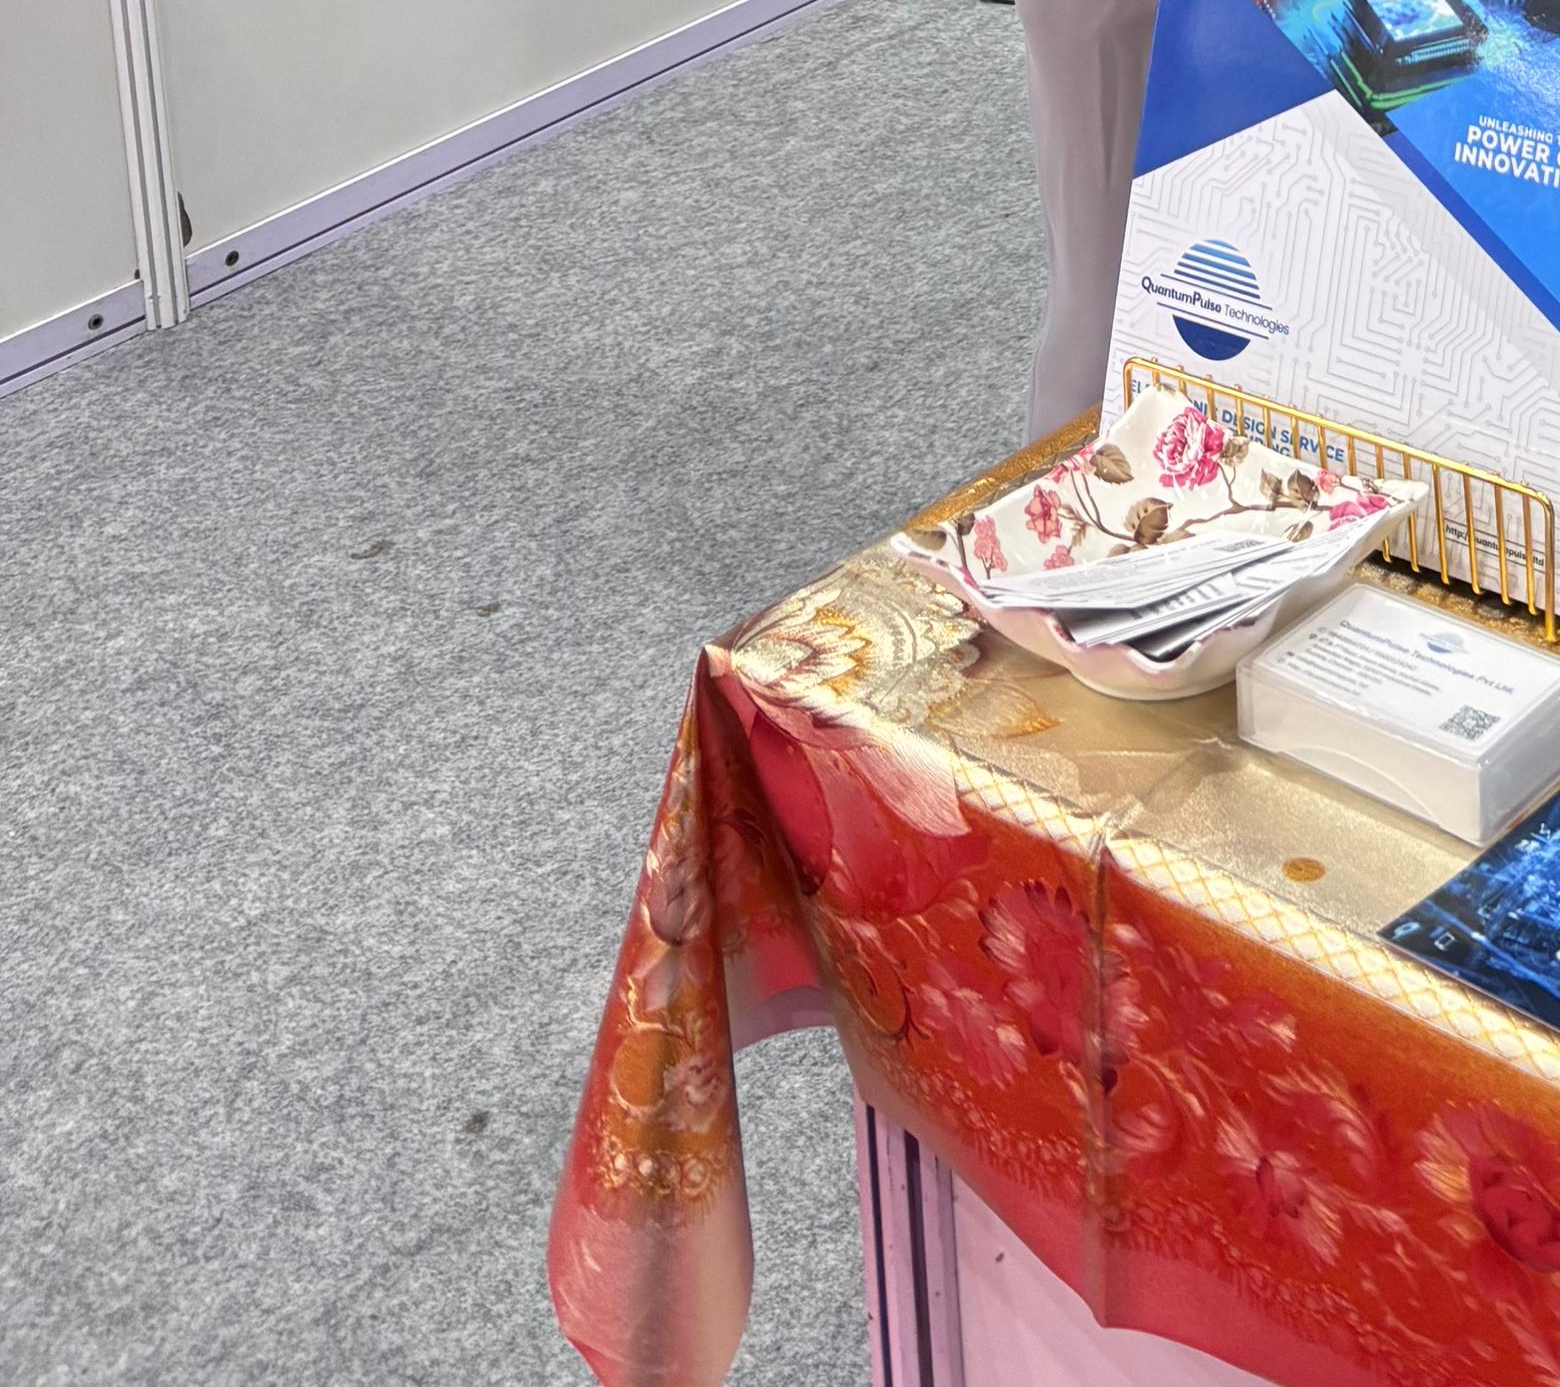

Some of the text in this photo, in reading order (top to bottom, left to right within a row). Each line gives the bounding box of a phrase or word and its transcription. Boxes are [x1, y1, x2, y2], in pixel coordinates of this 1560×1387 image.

[1467, 125, 1550, 164] POWER
[1479, 115, 1553, 144] UNLEASHING
[1224, 304, 1290, 336] Technologies
